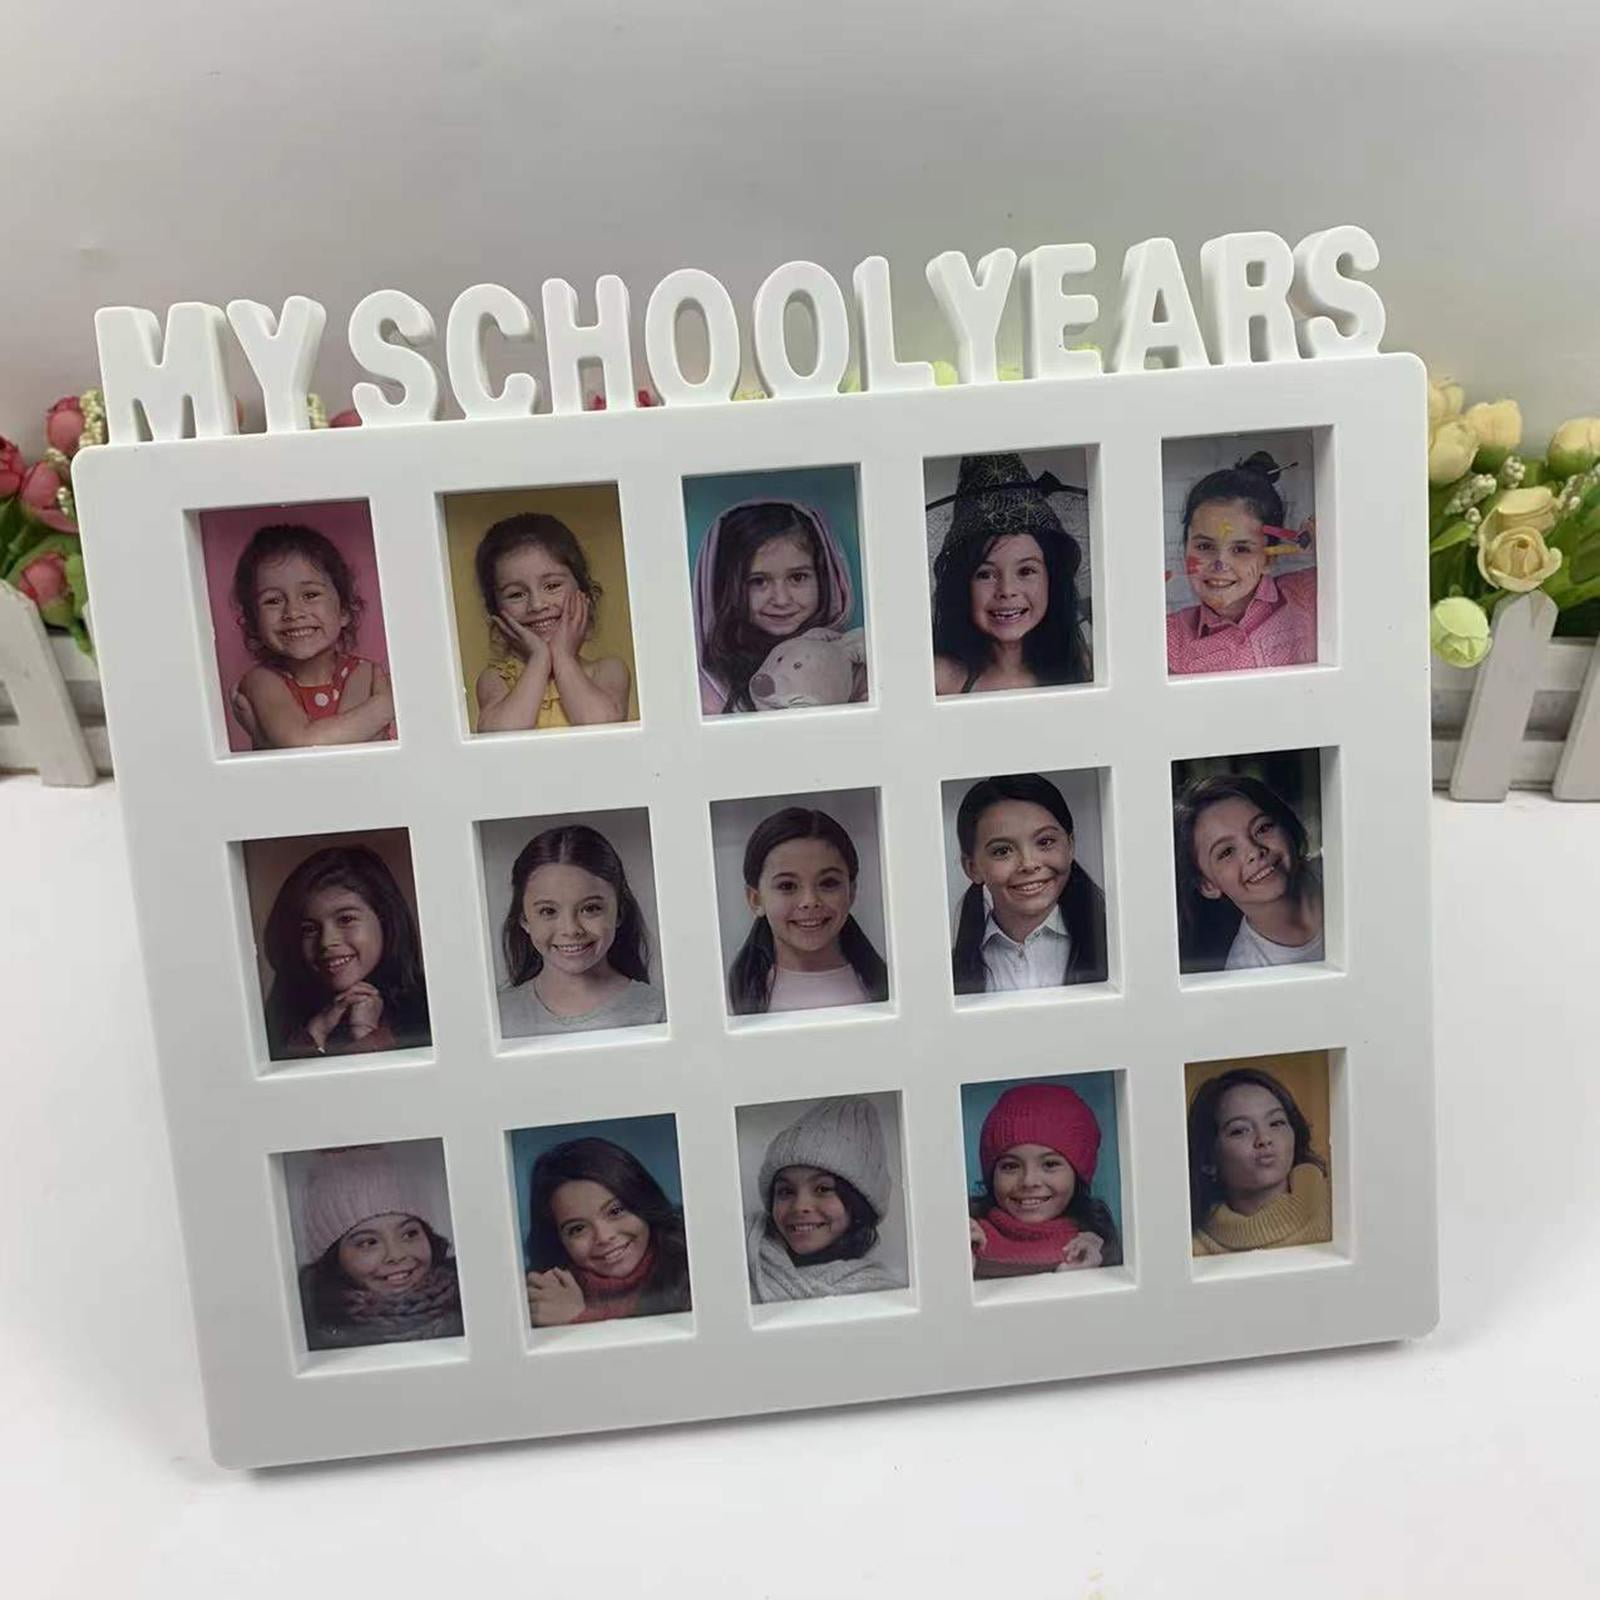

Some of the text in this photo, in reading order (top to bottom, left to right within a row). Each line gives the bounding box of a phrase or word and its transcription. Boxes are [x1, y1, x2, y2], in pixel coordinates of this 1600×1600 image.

[95, 225, 1386, 443] MY SCHOOL YEARS
